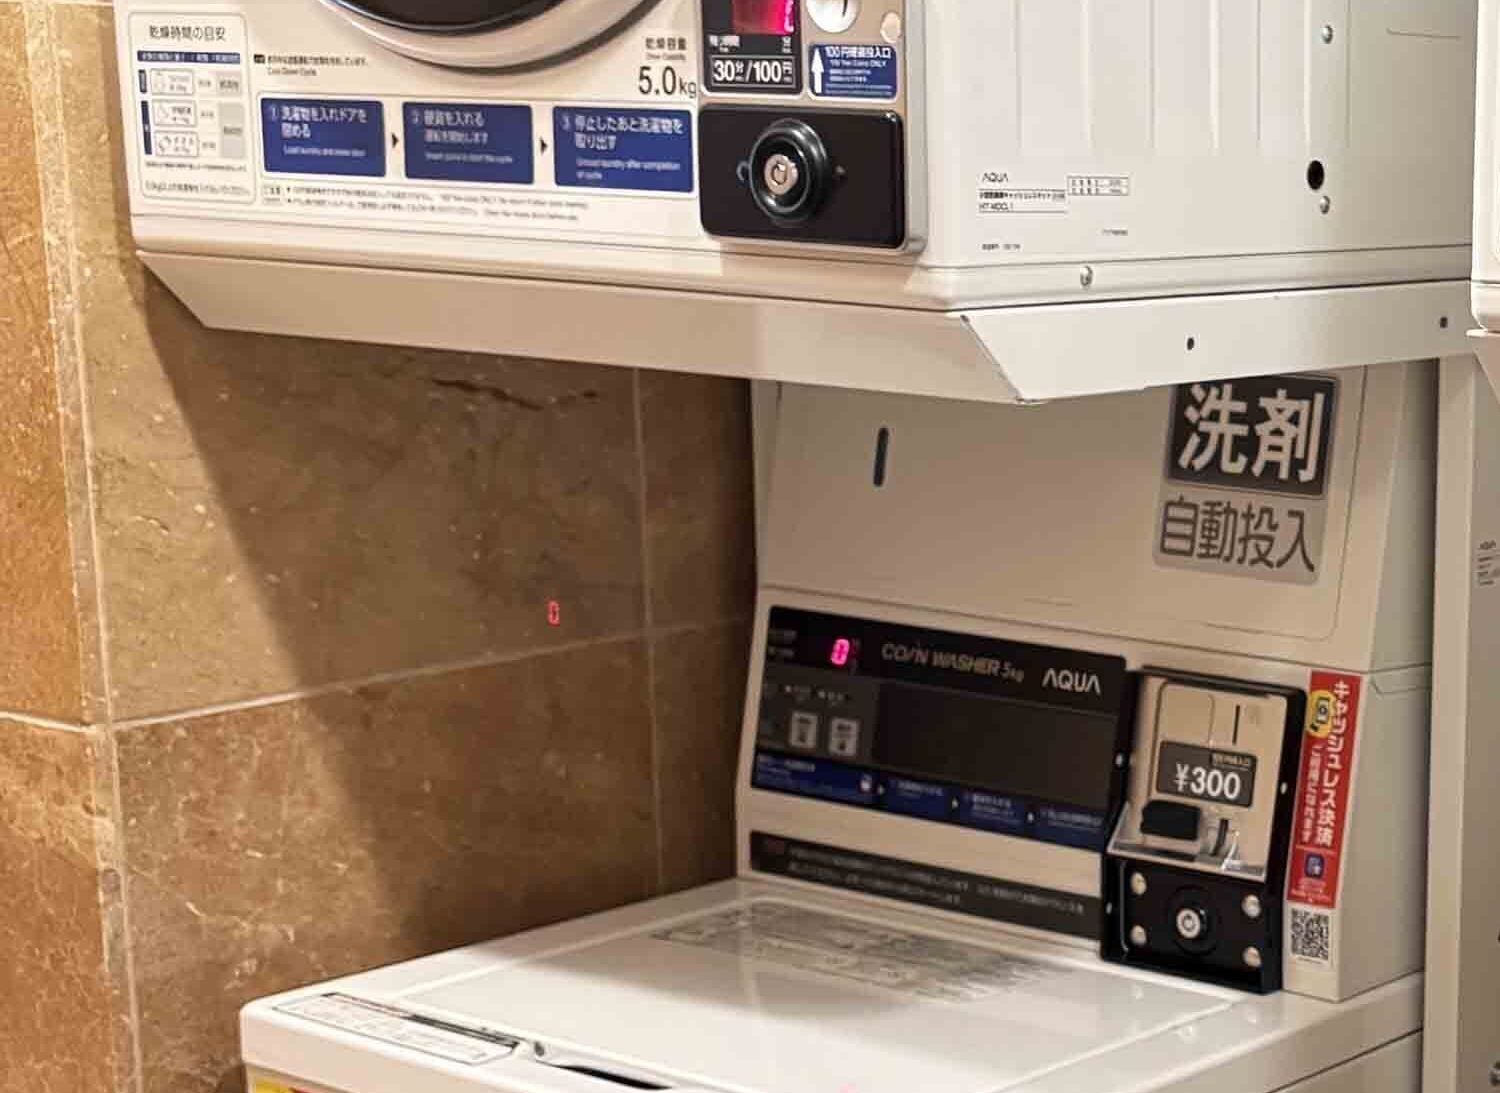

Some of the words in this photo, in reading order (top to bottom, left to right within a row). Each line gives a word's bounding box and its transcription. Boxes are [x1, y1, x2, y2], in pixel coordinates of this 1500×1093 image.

[982, 172, 1009, 183] AQUA
[1178, 383, 1326, 483] 洗剤
[1160, 493, 1315, 573] 自動投入
[931, 648, 1000, 677] WASHER
[1042, 667, 1101, 696] AQUA
[1175, 762, 1241, 800] ¥300
[1316, 680, 1350, 848] キャッシュレス決済
